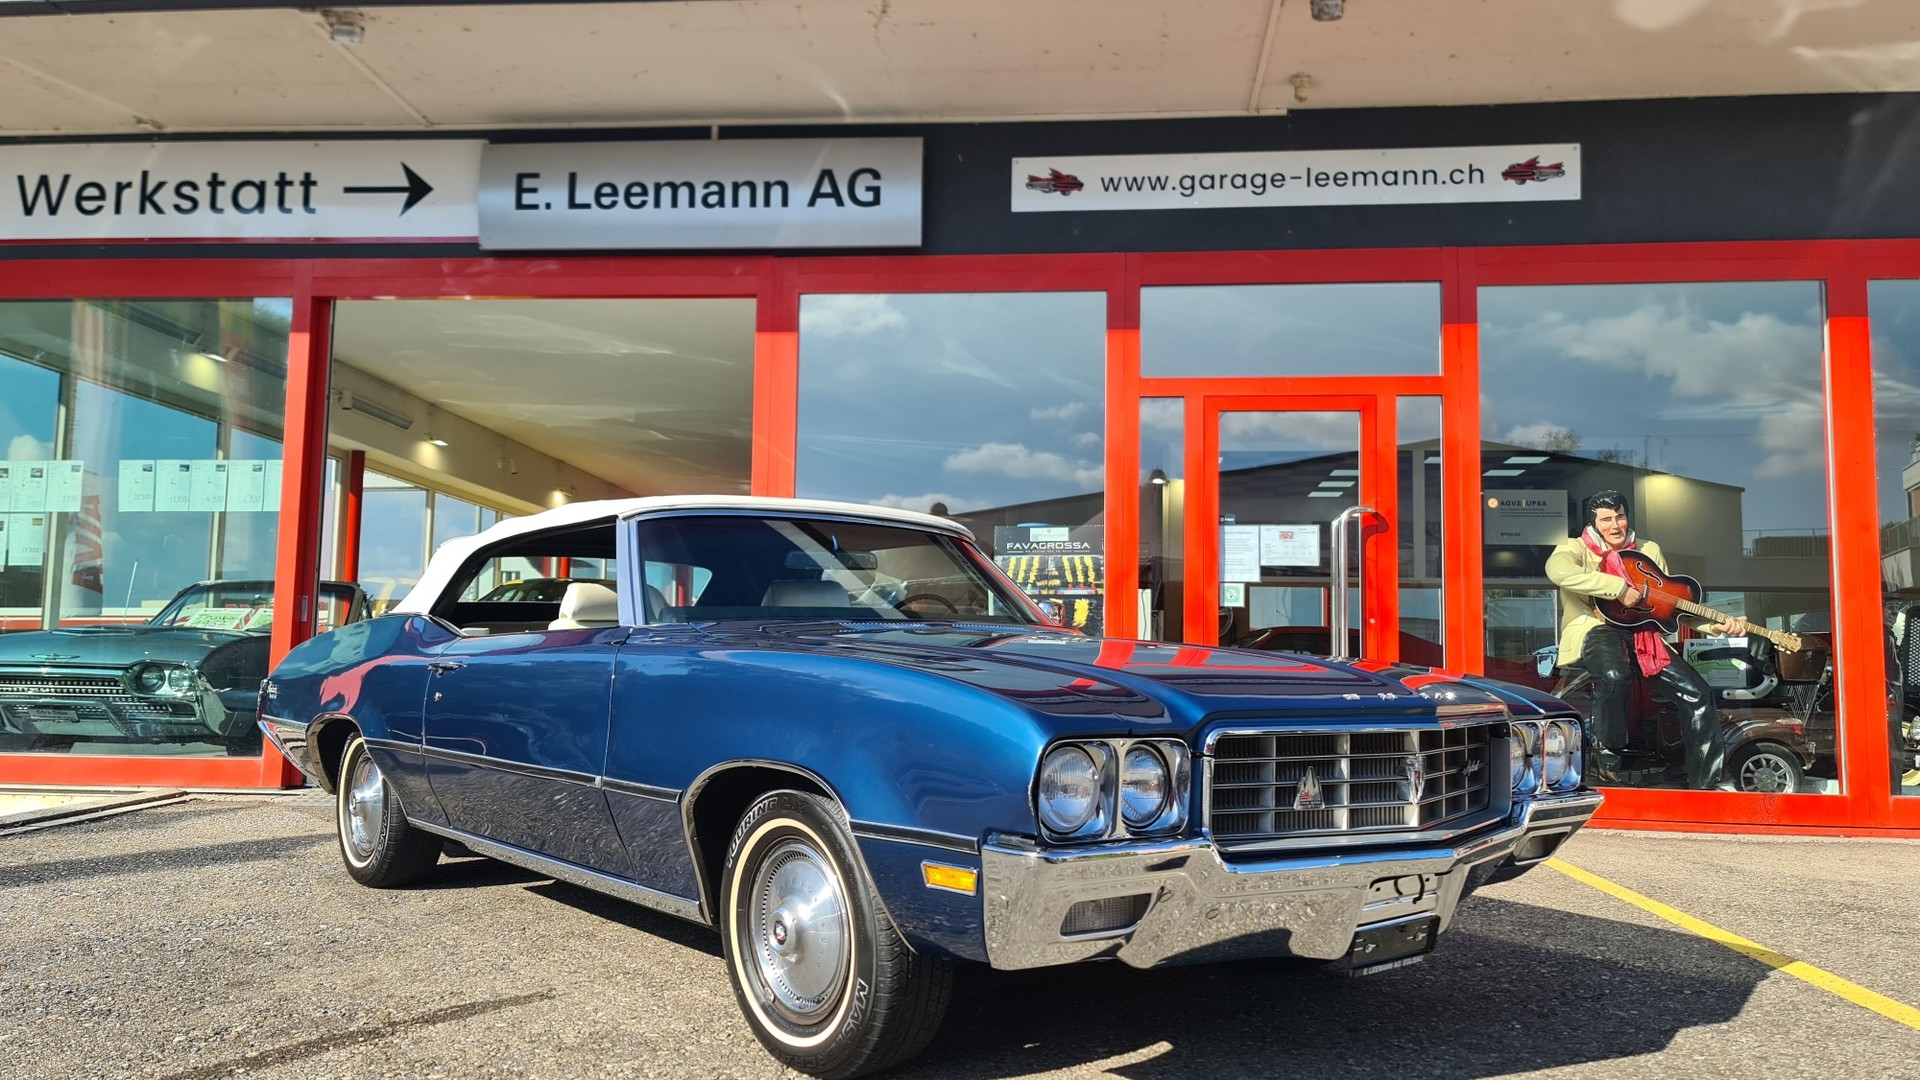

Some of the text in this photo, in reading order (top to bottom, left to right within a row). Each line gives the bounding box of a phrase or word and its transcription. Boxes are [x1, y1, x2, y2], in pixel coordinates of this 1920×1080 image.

[17, 170, 318, 217] Werkstatt
[514, 167, 882, 210] E. Leemann AG
[1100, 163, 1485, 197] www.garage-leemann.ch
[1006, 542, 1091, 550] FAVAGROSSA
